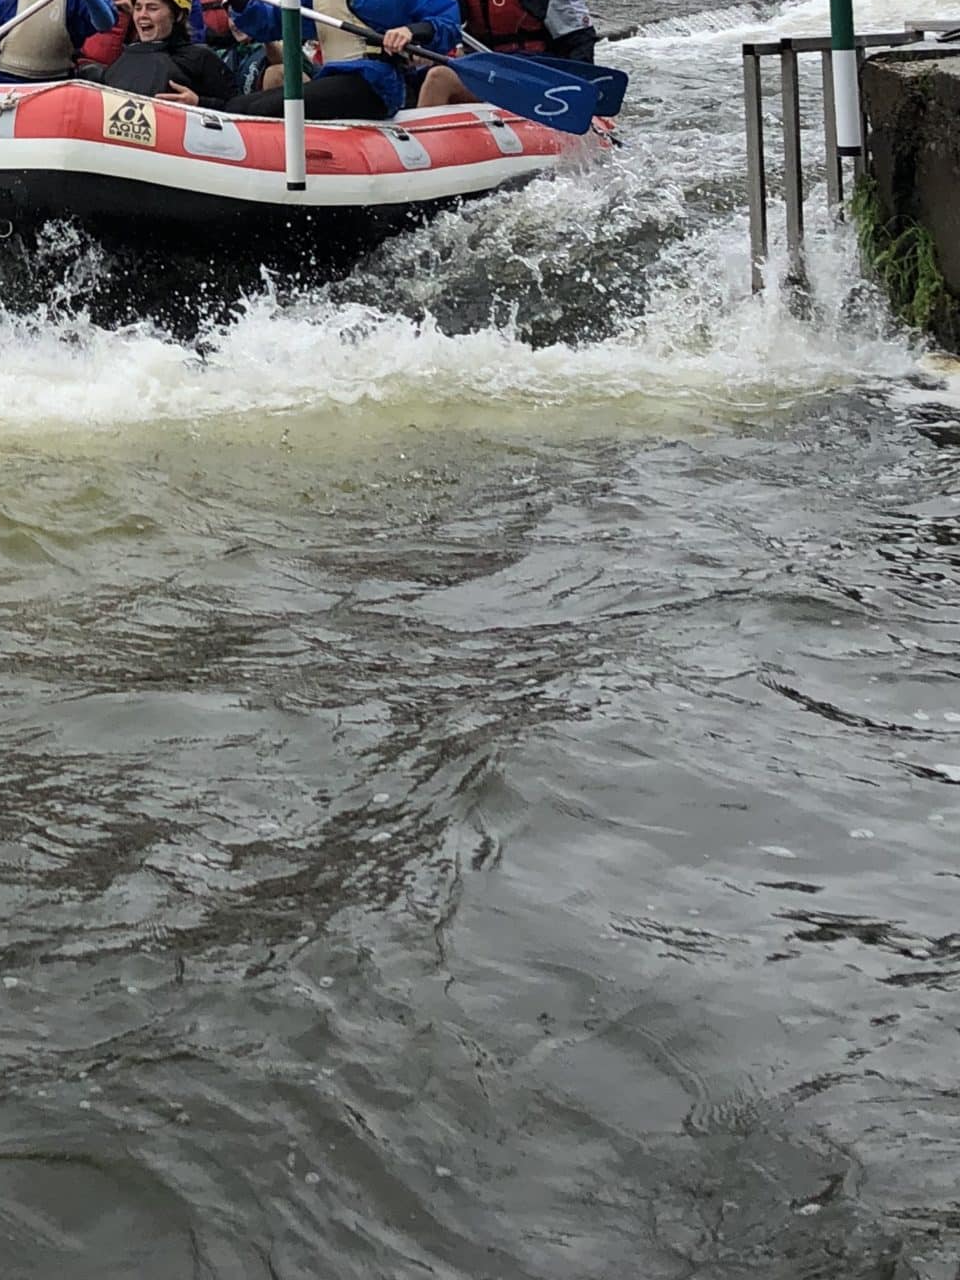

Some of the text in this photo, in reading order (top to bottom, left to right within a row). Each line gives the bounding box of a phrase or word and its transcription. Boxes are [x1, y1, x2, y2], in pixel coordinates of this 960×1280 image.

[534, 85, 582, 116] S
[108, 128, 150, 142] DESIGN
[109, 121, 152, 137] AQUA
